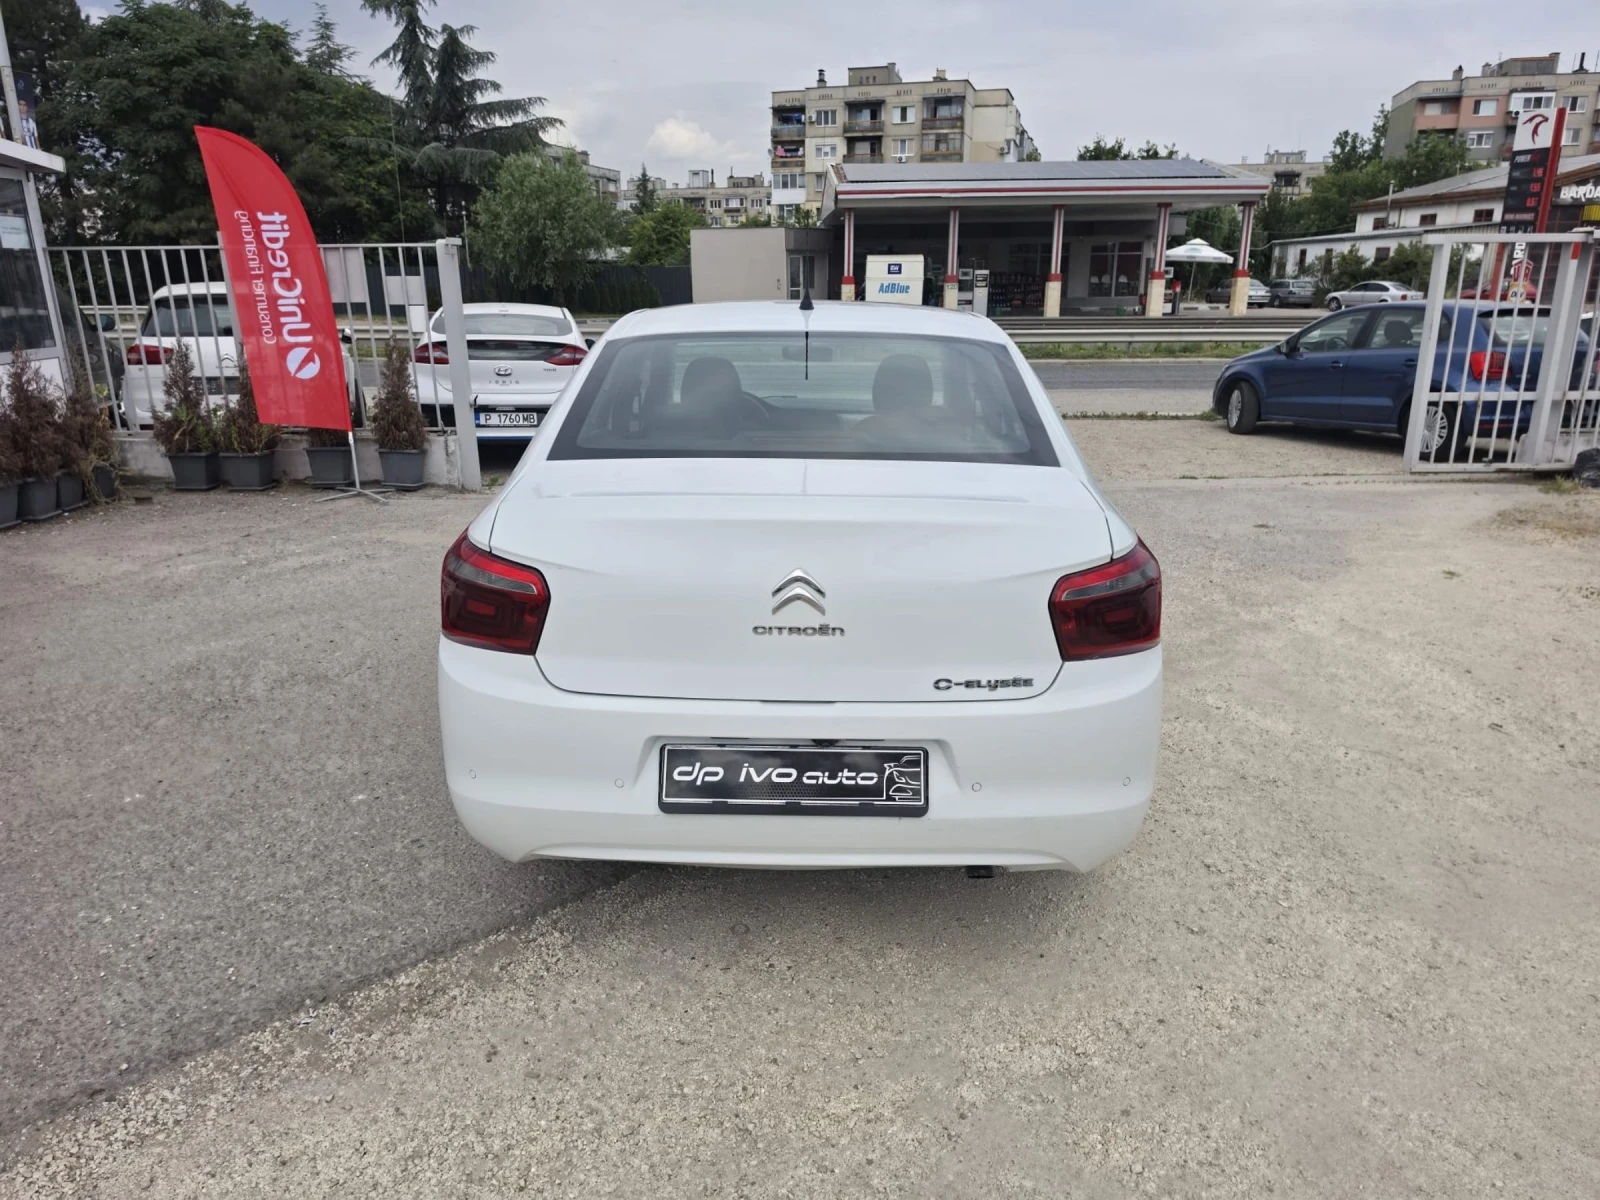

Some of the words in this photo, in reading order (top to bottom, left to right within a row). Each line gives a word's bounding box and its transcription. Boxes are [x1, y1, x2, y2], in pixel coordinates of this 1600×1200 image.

[878, 282, 911, 294] AdBlue
[497, 413, 521, 424] 1760
[522, 413, 536, 424] MB
[672, 762, 725, 786] dp
[739, 763, 798, 783] ivo
[802, 771, 879, 785] auto
